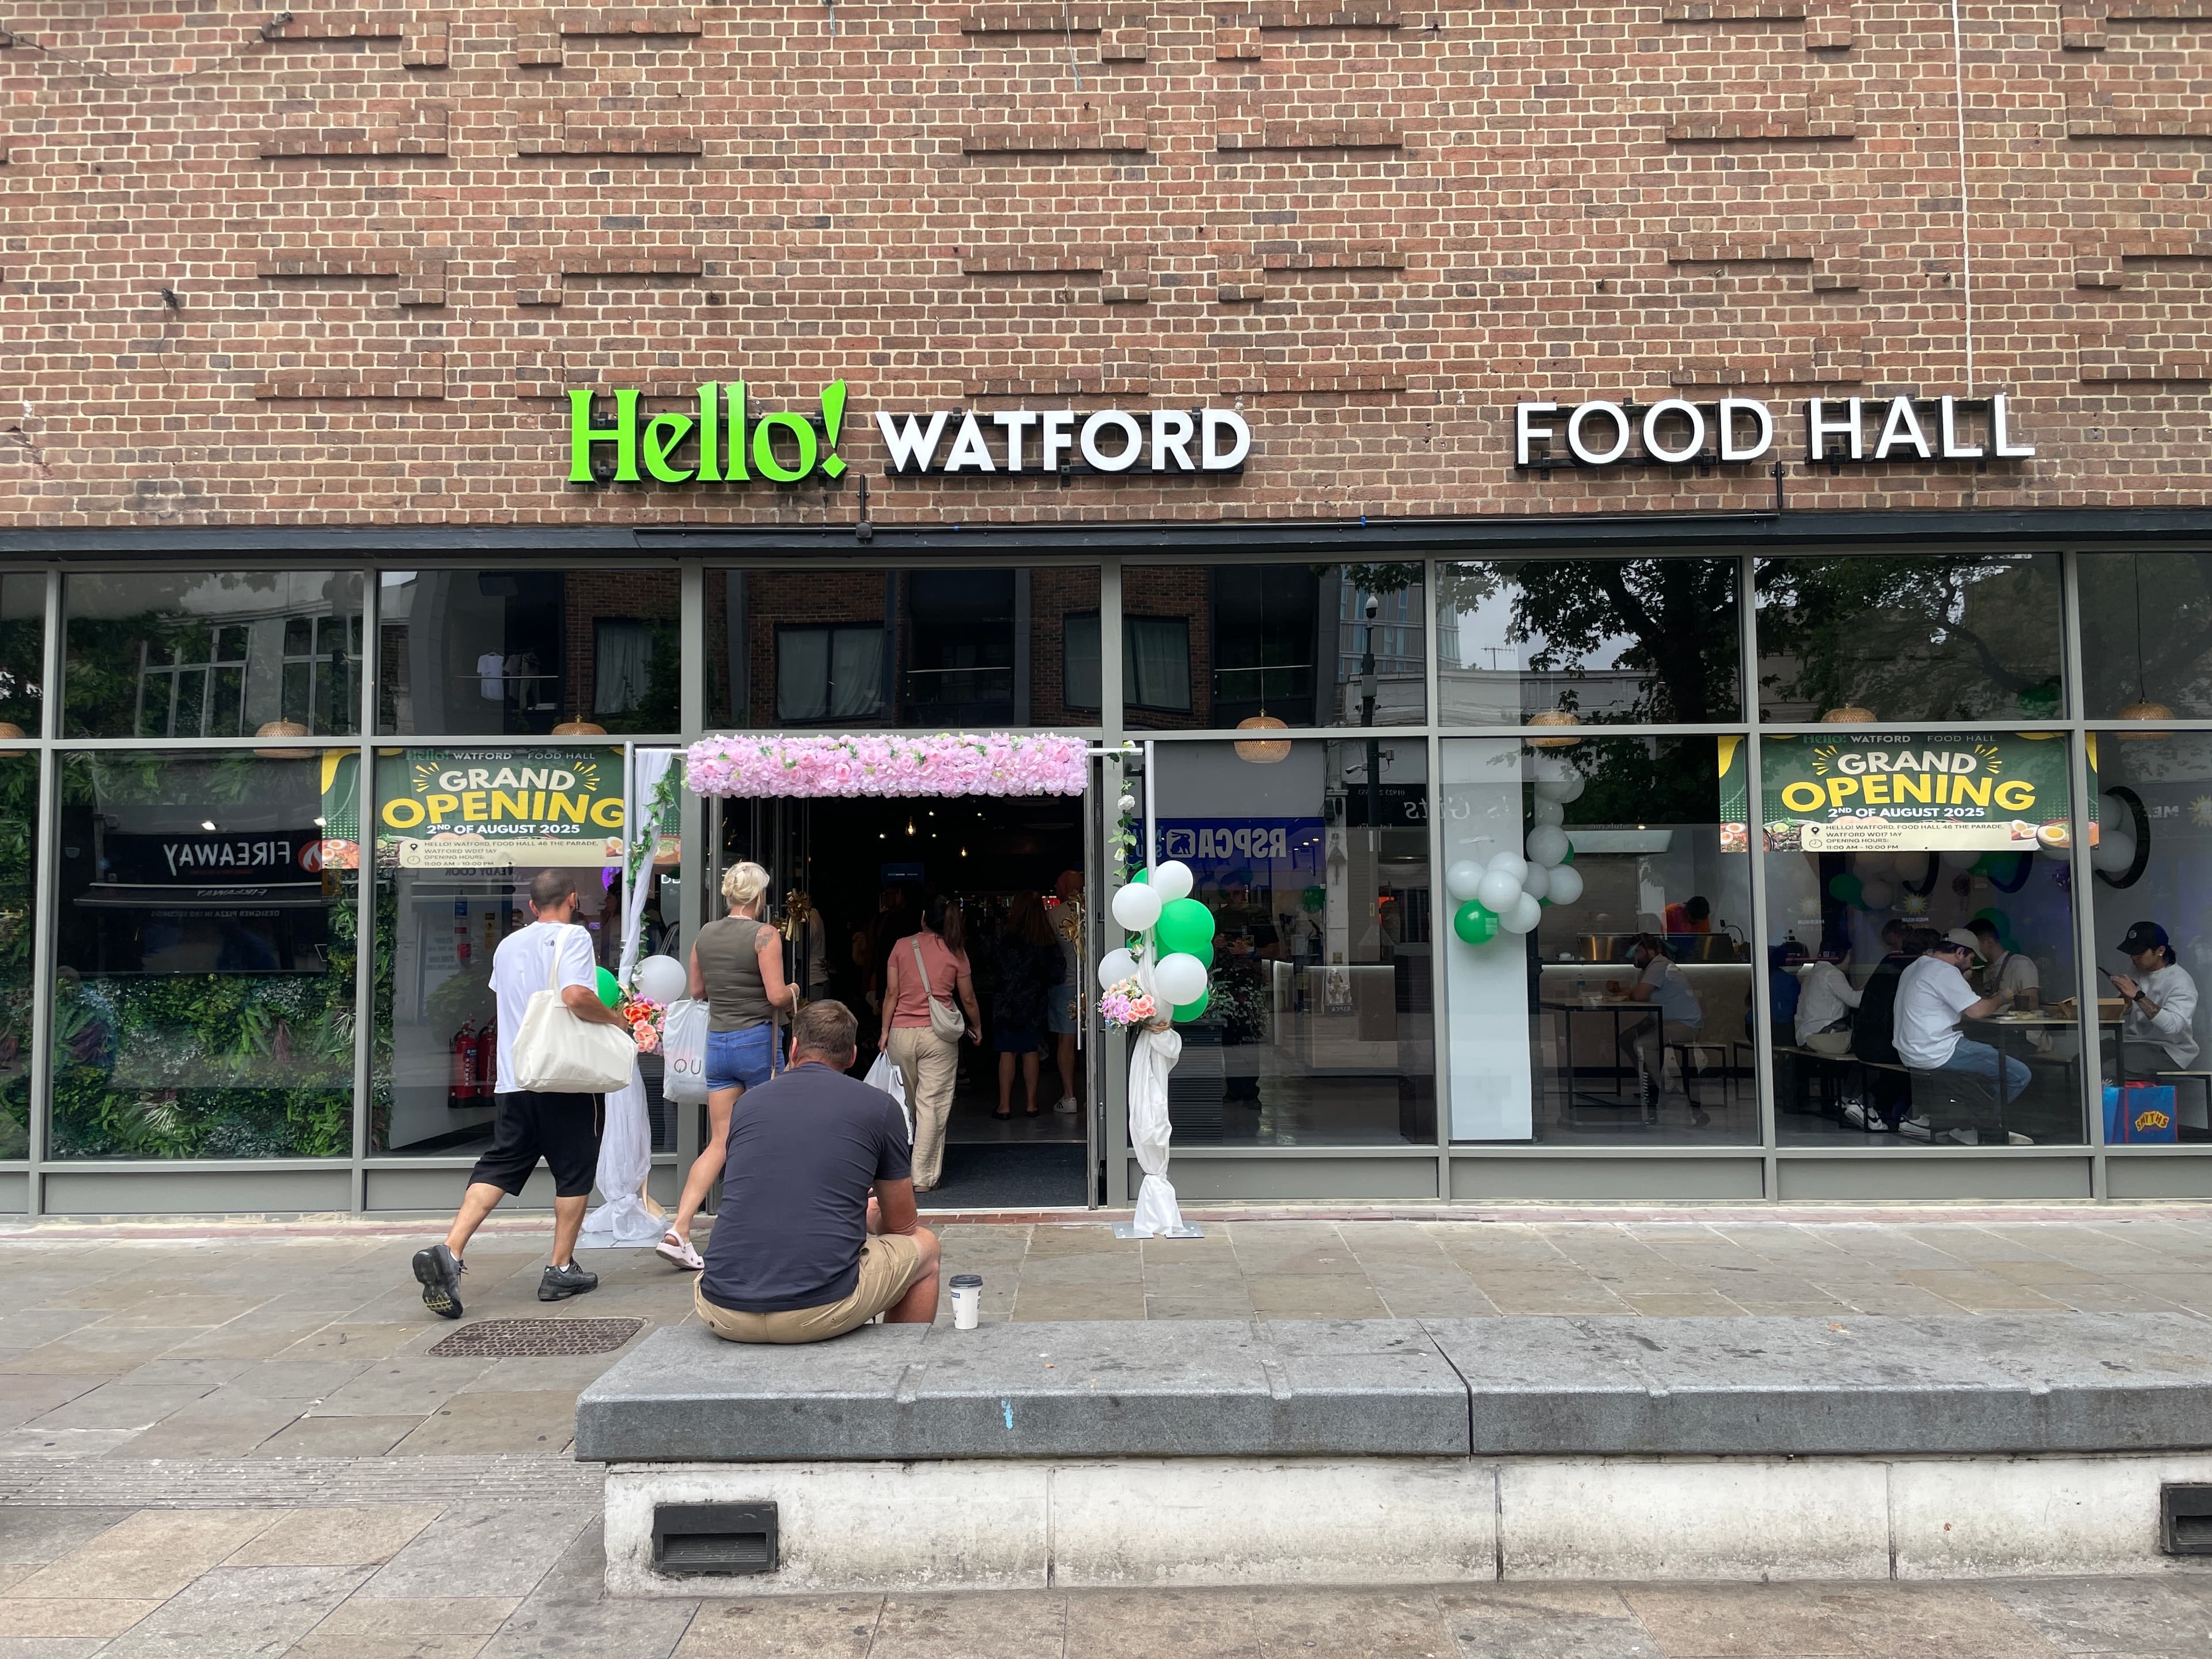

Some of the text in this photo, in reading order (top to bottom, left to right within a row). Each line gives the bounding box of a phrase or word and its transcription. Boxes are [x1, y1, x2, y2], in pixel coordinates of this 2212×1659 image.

[567, 378, 1252, 484] Hello! WATFORD
[1517, 395, 2036, 465] FOOD HALL
[1850, 735, 1911, 743] WATFORD
[453, 752, 512, 760] WATFORD
[1837, 751, 1977, 775] GRAND
[439, 768, 575, 792] GRAND
[1781, 774, 2036, 812] OPENING
[382, 790, 624, 828] OPENING
[1827, 807, 1985, 817] 2ND OF AUGUST 2025
[426, 824, 581, 834] 2ND OF AUGUST 2025
[2136, 1113, 2169, 1130] SMYTHS
